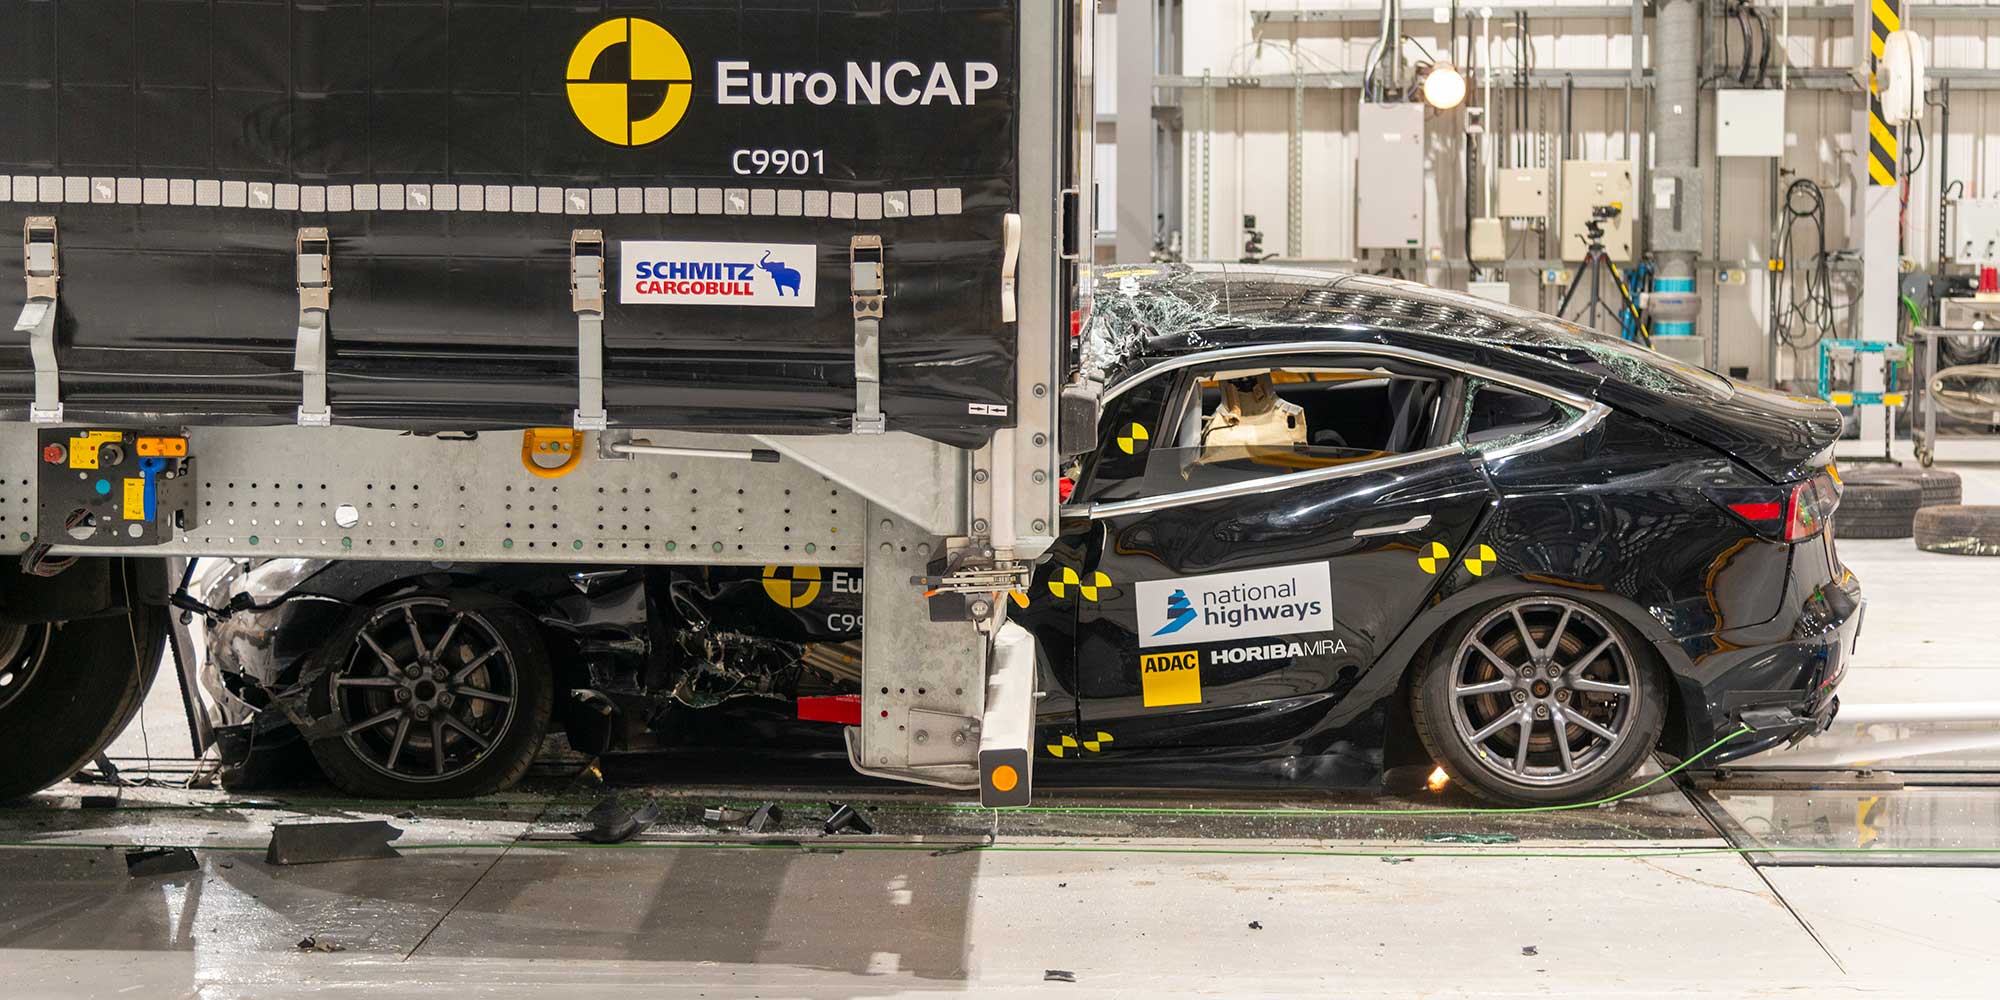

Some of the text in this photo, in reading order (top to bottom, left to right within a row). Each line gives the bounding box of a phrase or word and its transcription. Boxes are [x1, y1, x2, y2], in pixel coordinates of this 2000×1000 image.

[718, 61, 998, 105] Euro NCAP
[733, 149, 824, 175] C9901
[635, 261, 755, 281] SCHMITZ
[635, 281, 754, 296] CARGOBULL
[1203, 577, 1297, 606] national
[1204, 600, 1321, 628] highways
[1144, 653, 1196, 673] ADAC
